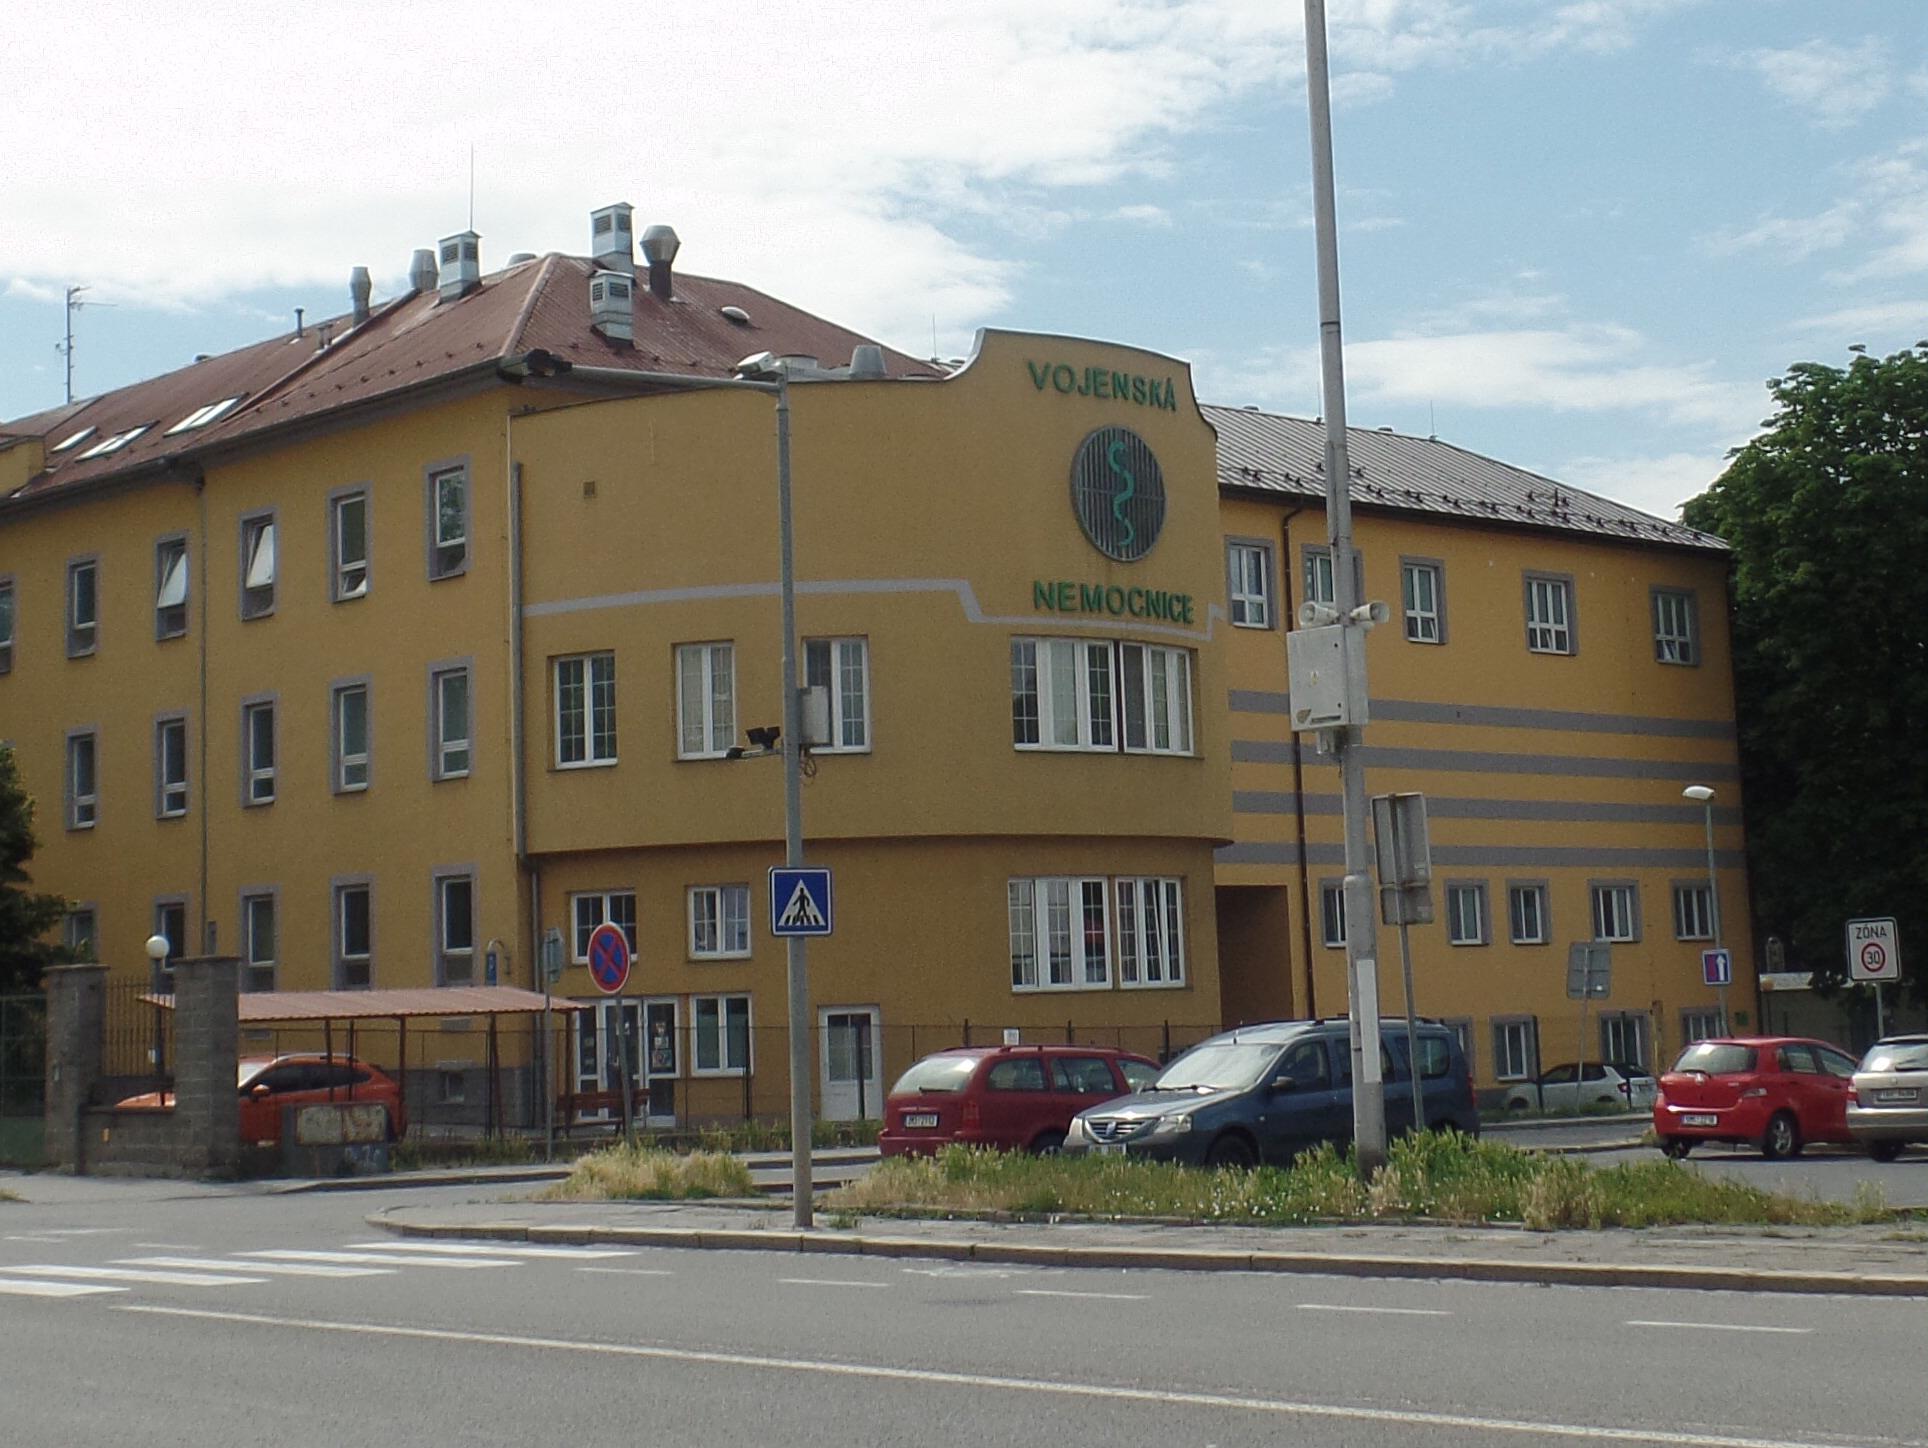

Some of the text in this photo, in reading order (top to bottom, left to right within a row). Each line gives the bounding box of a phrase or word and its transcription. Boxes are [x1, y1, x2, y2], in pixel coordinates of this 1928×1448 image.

[1028, 360, 1176, 412] VOJENSKÁ
[1033, 580, 1194, 624] NEMOCNICE
[1856, 924, 1887, 939] ZÓNA
[1866, 950, 1880, 965] 30
